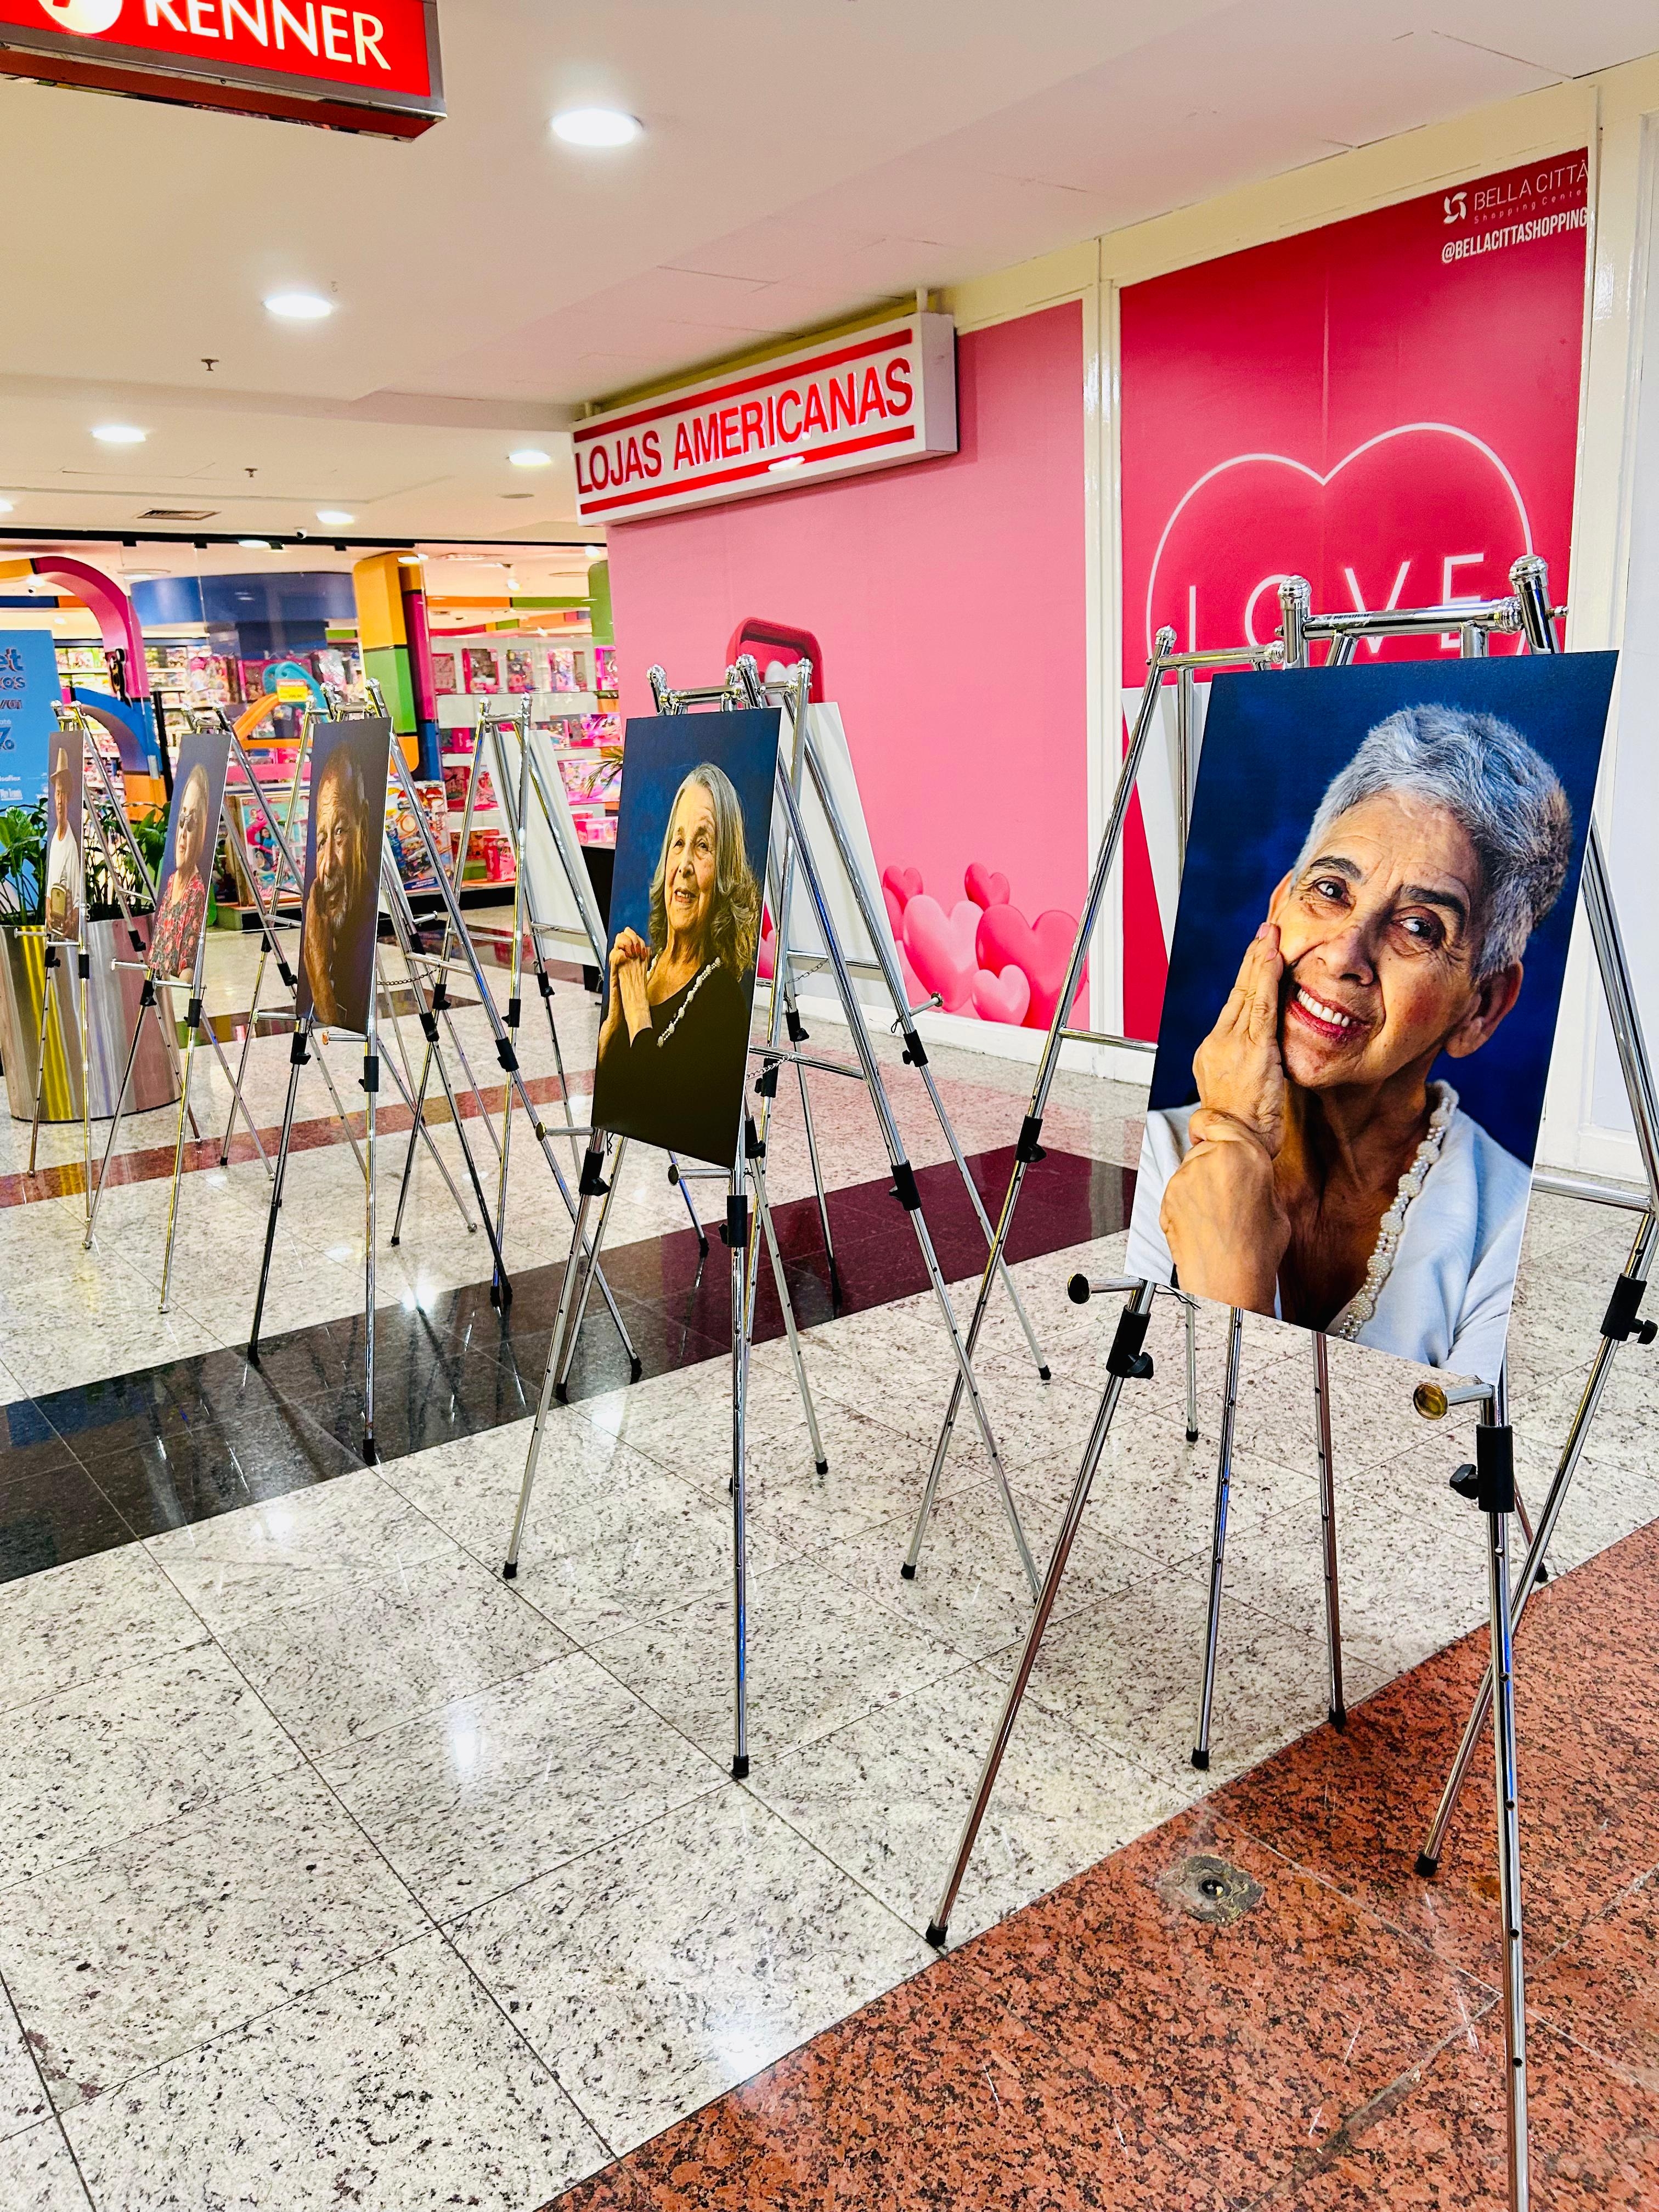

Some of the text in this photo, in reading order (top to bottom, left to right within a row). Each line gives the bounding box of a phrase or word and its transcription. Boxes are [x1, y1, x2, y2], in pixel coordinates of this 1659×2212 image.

[145, 0, 392, 71] RENNER
[1474, 178, 1532, 211] BELLA
[1474, 201, 1536, 224] Shopping
[1441, 206, 1588, 264] @BELLACITTASHOPPING
[575, 358, 915, 494] LOJAS AMERICANAS
